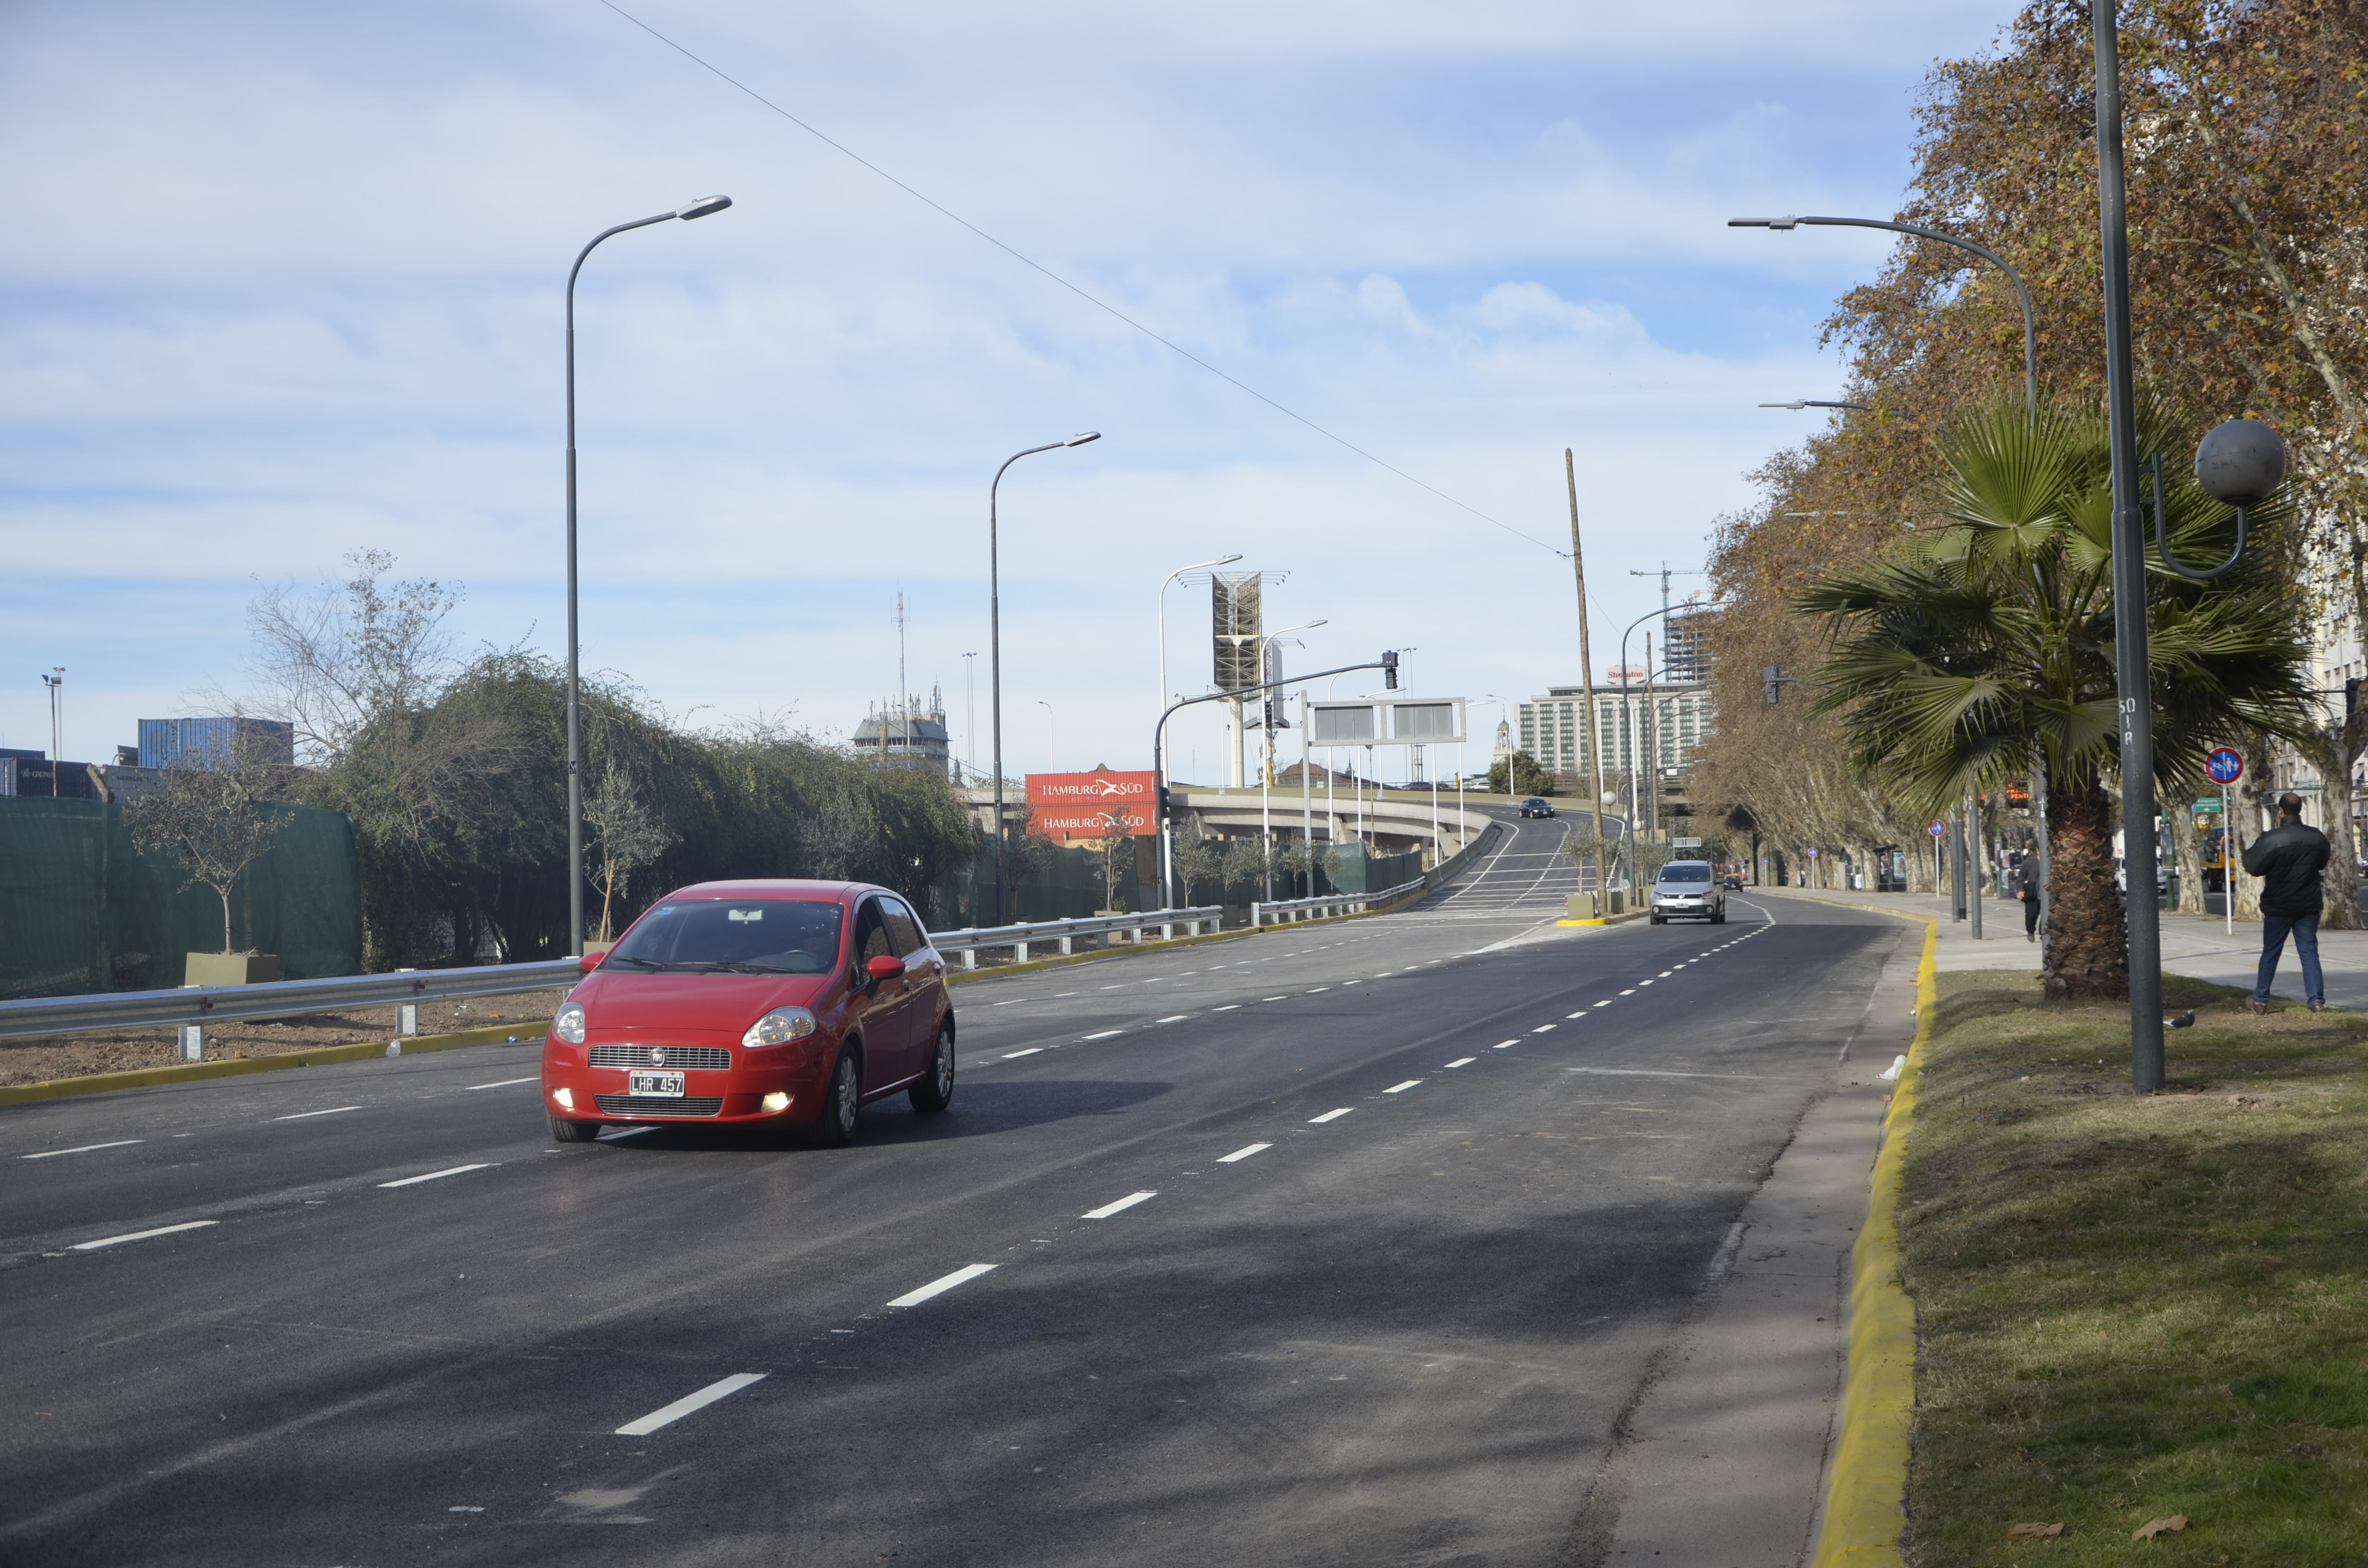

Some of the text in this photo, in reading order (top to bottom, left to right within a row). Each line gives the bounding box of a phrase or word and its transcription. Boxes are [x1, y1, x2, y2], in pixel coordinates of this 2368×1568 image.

[2120, 698, 2135, 714] 50
[1043, 782, 1143, 796] HAMBURG SÜD
[1044, 816, 1144, 828] HAMBURG SÜD
[653, 1054, 663, 1063] FIAT
[632, 1077, 682, 1092] LHR 457
